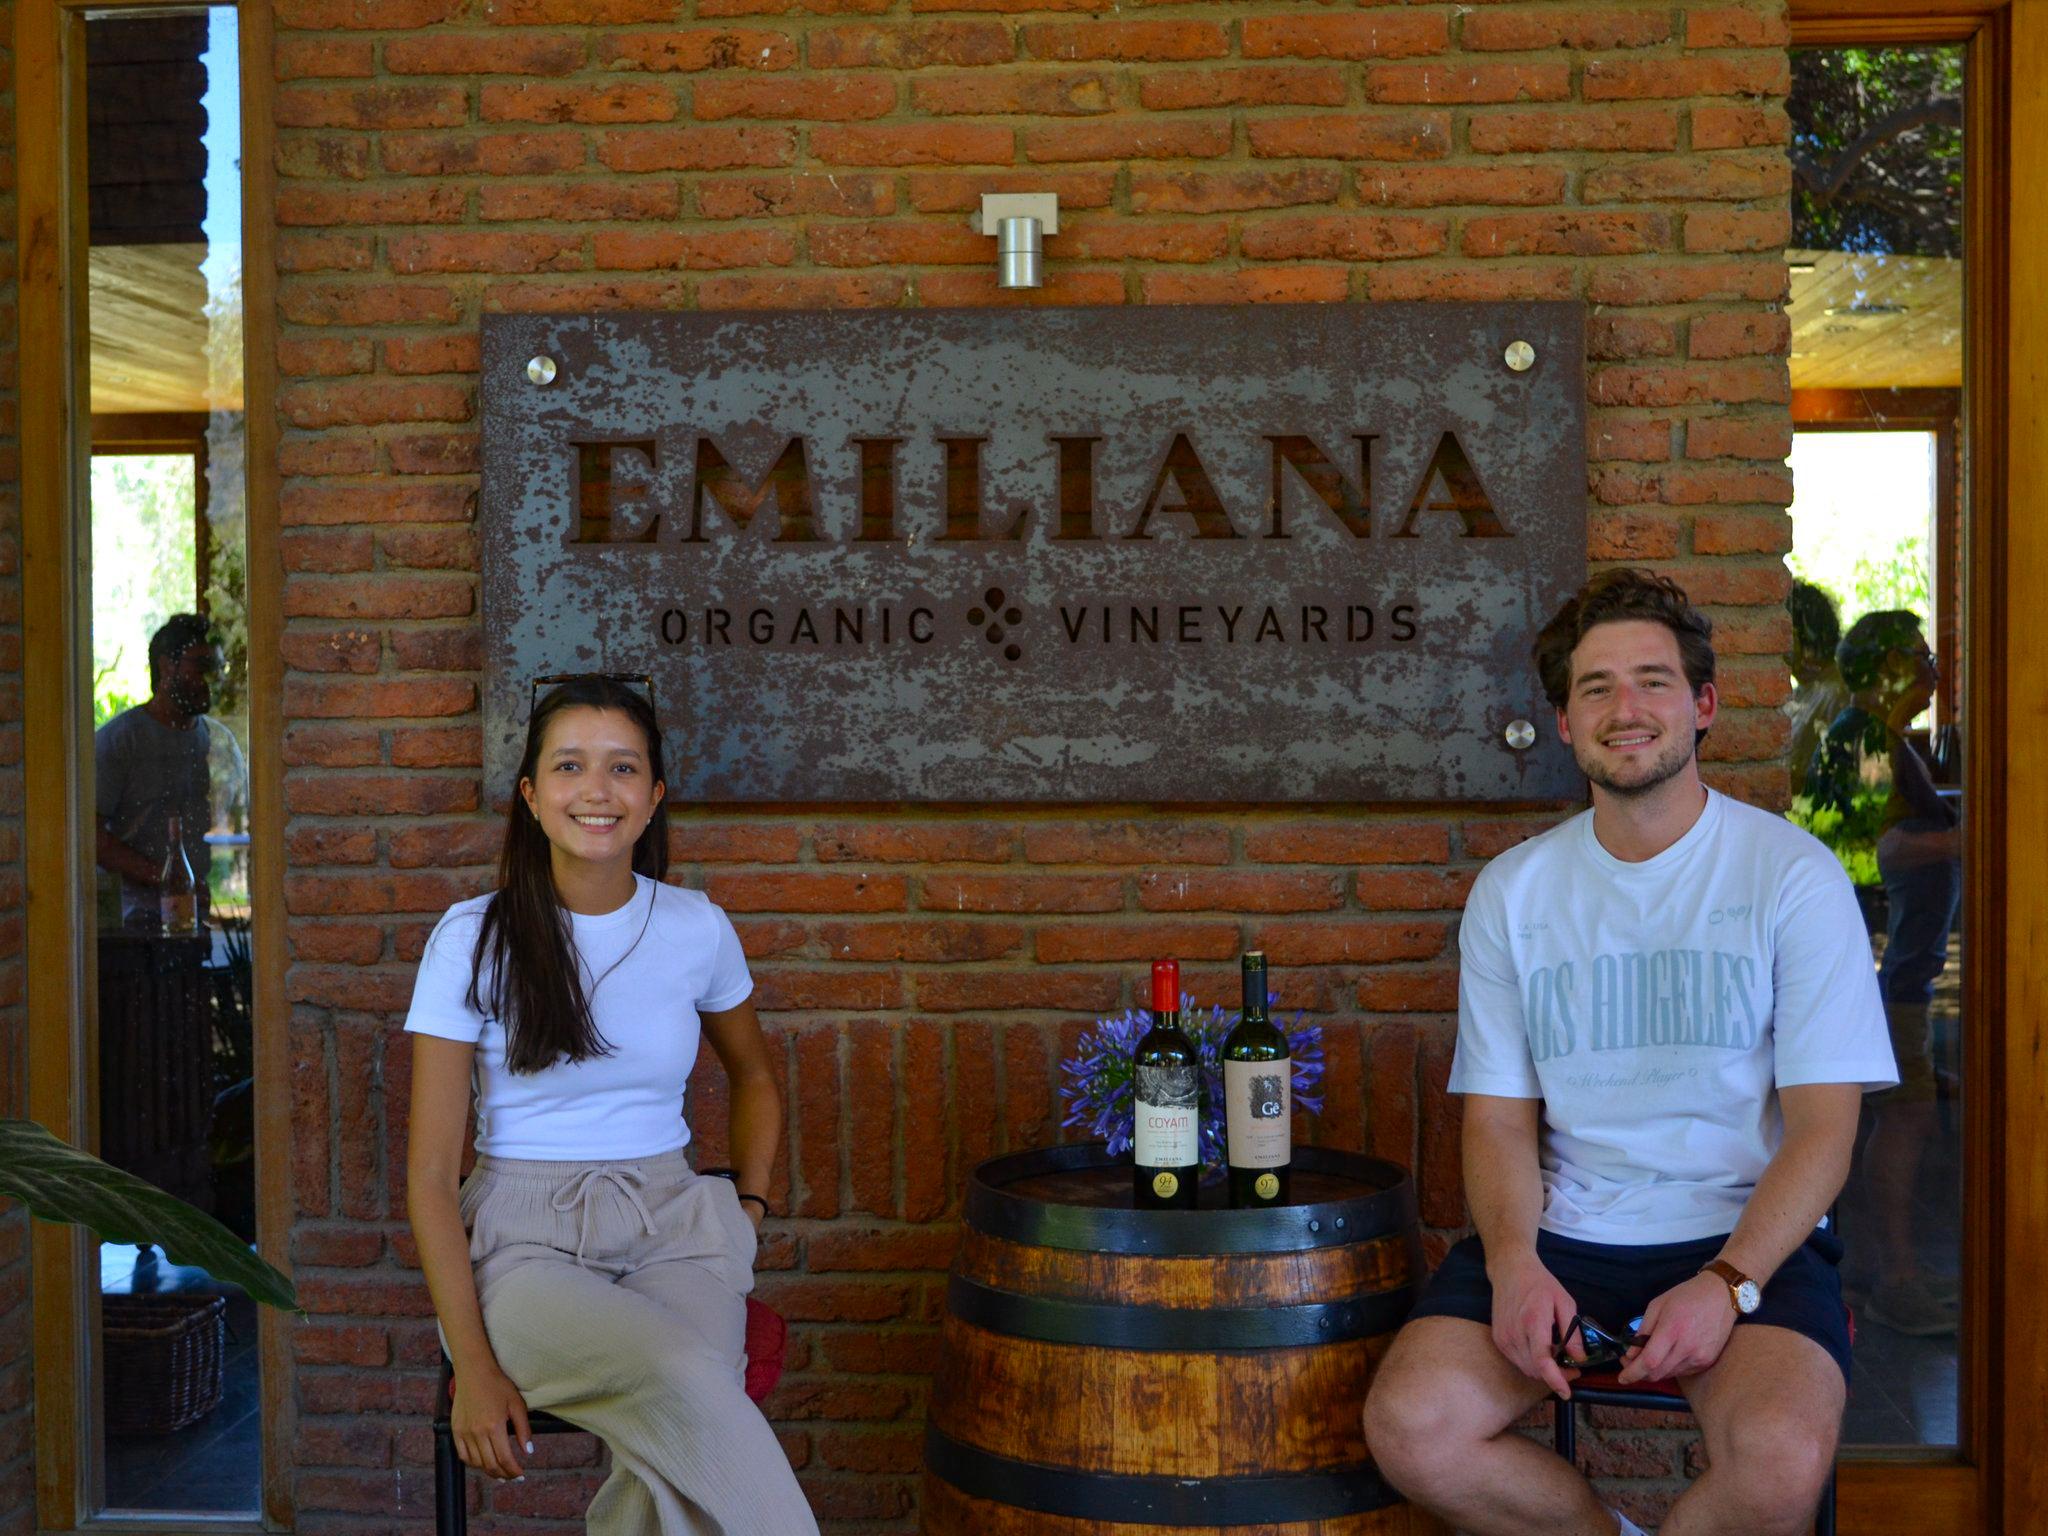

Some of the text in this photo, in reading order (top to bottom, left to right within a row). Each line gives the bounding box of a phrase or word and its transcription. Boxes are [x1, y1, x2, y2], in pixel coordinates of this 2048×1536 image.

[569, 431, 1516, 544] EMILIANA
[661, 605, 1417, 645] ORGANIC VINEYARDS
[1527, 949, 1757, 1062] OS ANGELES
[1575, 1071, 1641, 1088] Weekend
[1148, 1116, 1188, 1129] COYAM
[1260, 1178, 1274, 1191] 97
